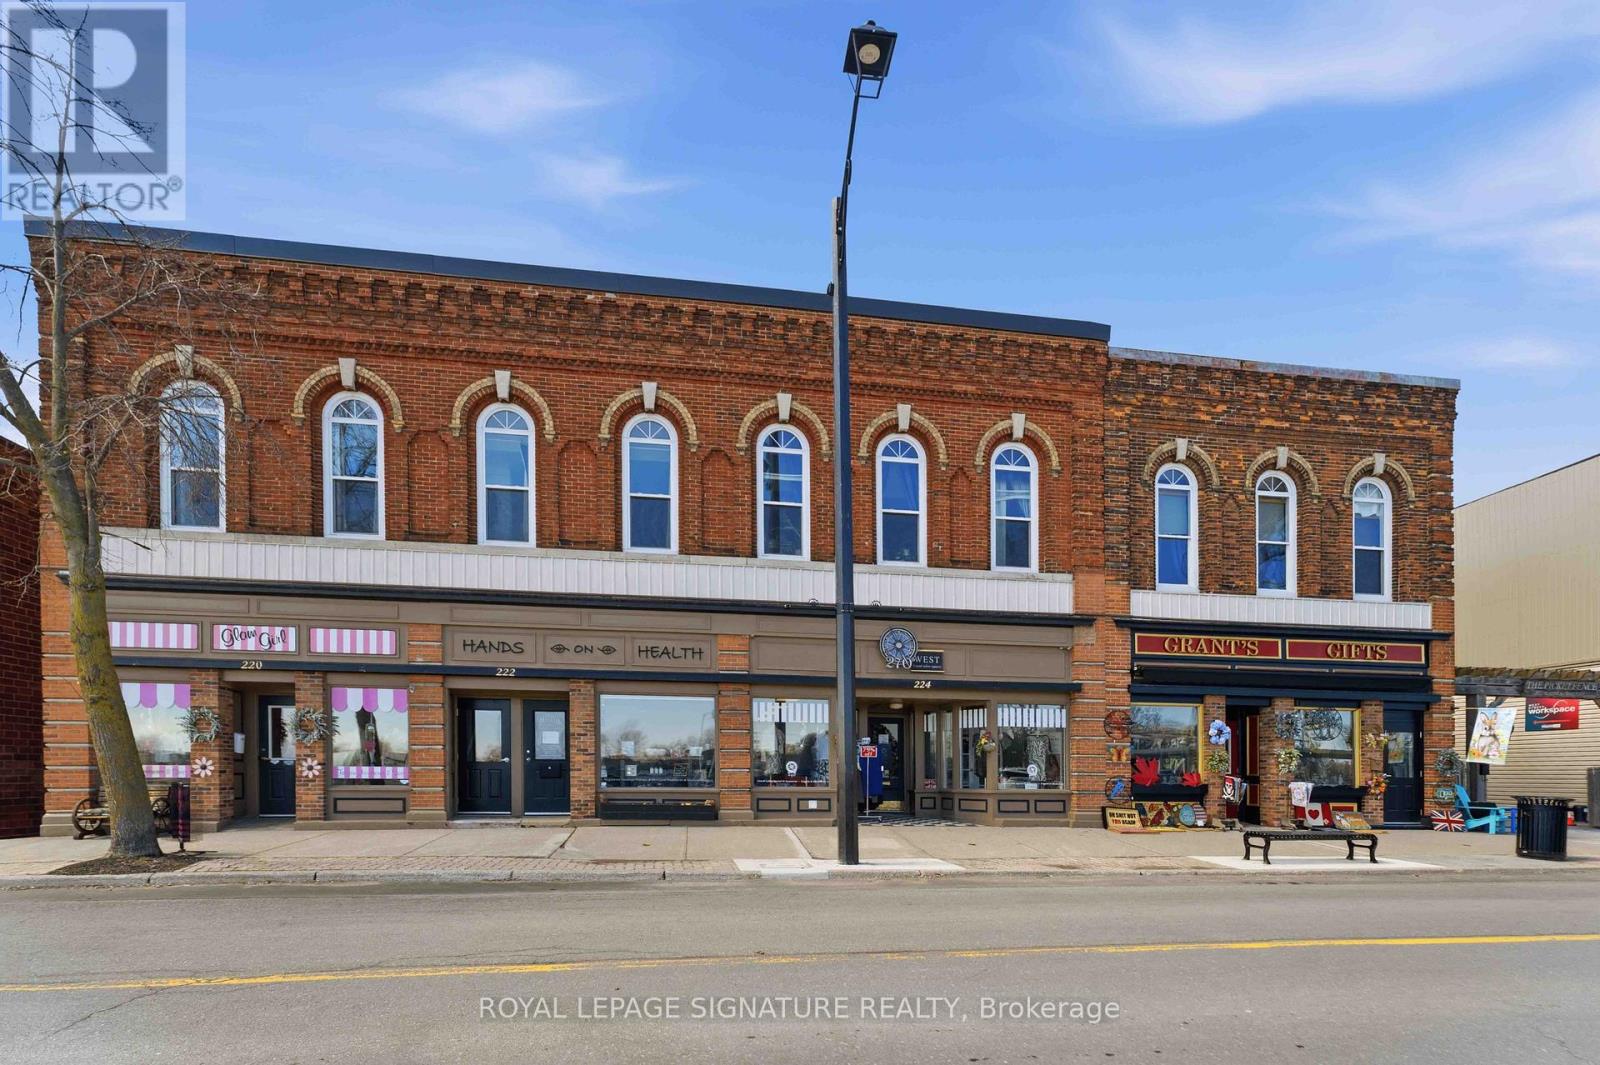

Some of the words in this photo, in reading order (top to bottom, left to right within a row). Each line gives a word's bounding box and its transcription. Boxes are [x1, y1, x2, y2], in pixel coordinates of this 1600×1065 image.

[221, 627, 257, 647] Glam
[259, 629, 286, 650] Girl
[463, 639, 525, 654] HANDS
[573, 645, 594, 654] ON
[638, 645, 704, 660] HEALTH
[1164, 637, 1259, 656] GRANT'S
[1327, 642, 1388, 660] GIFTS
[241, 661, 263, 670] 220
[885, 656, 912, 669] 270
[913, 655, 940, 664] WEST
[496, 668, 516, 677] 222
[913, 680, 932, 689] 224
[1528, 706, 1576, 715] workspace
